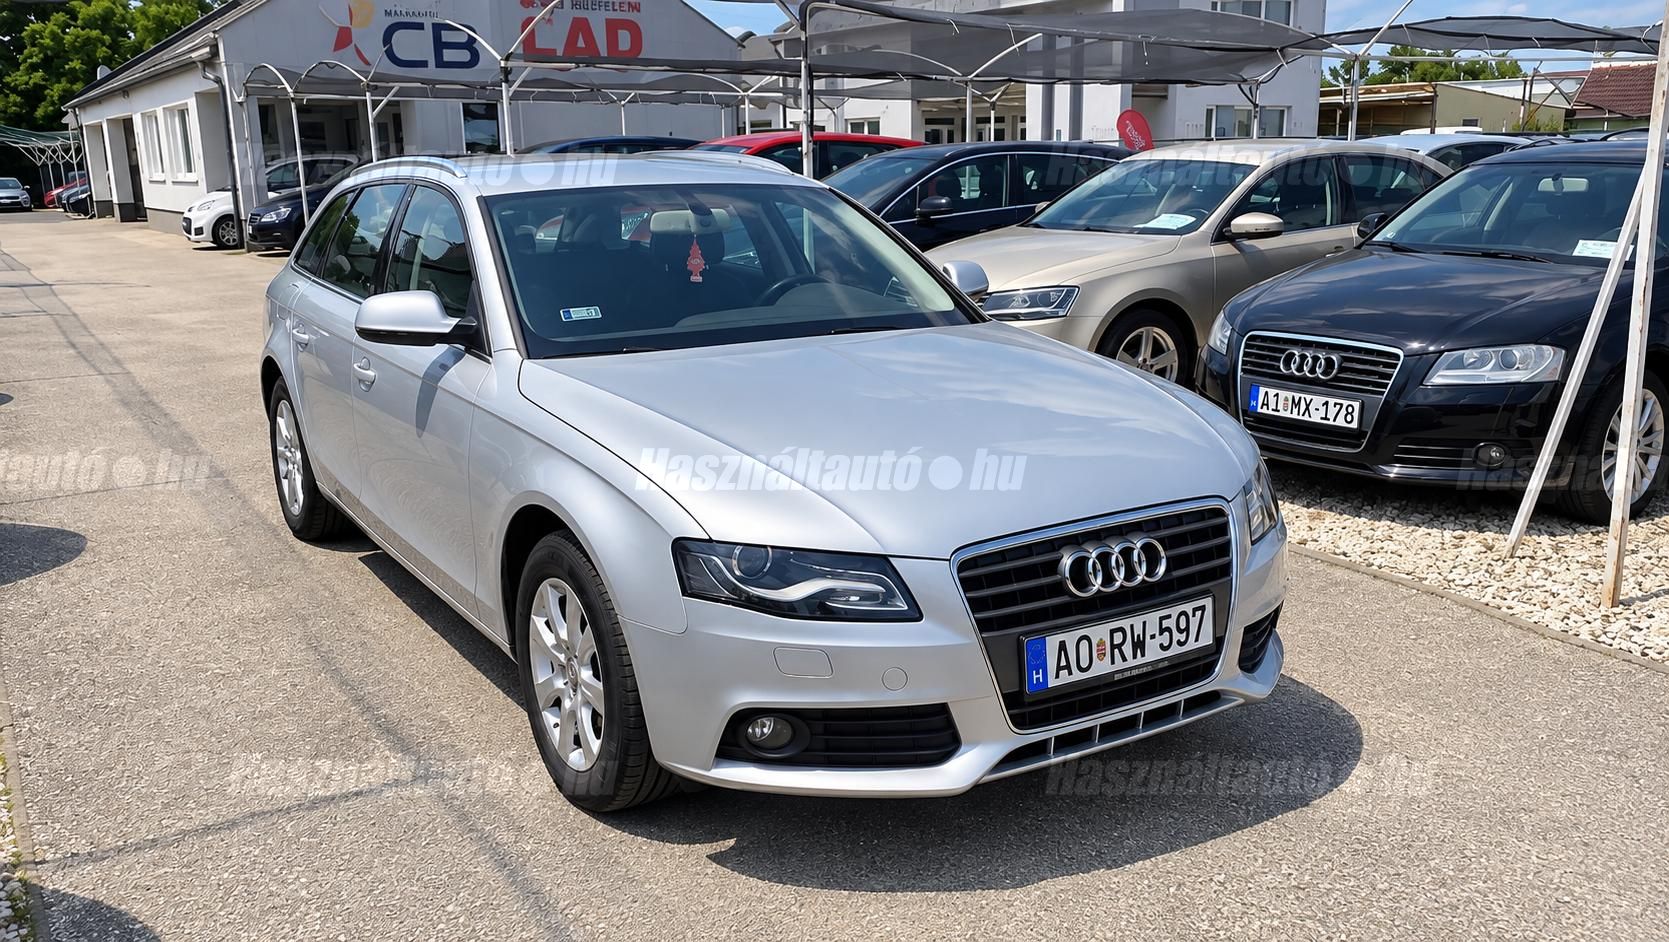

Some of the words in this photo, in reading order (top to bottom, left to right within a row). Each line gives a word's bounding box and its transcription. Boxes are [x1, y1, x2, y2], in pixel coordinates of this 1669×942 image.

[382, 21, 480, 69] CB
[1290, 394, 1355, 425] MX-178
[1032, 668, 1043, 685] H
[1109, 604, 1207, 666] RW-597
